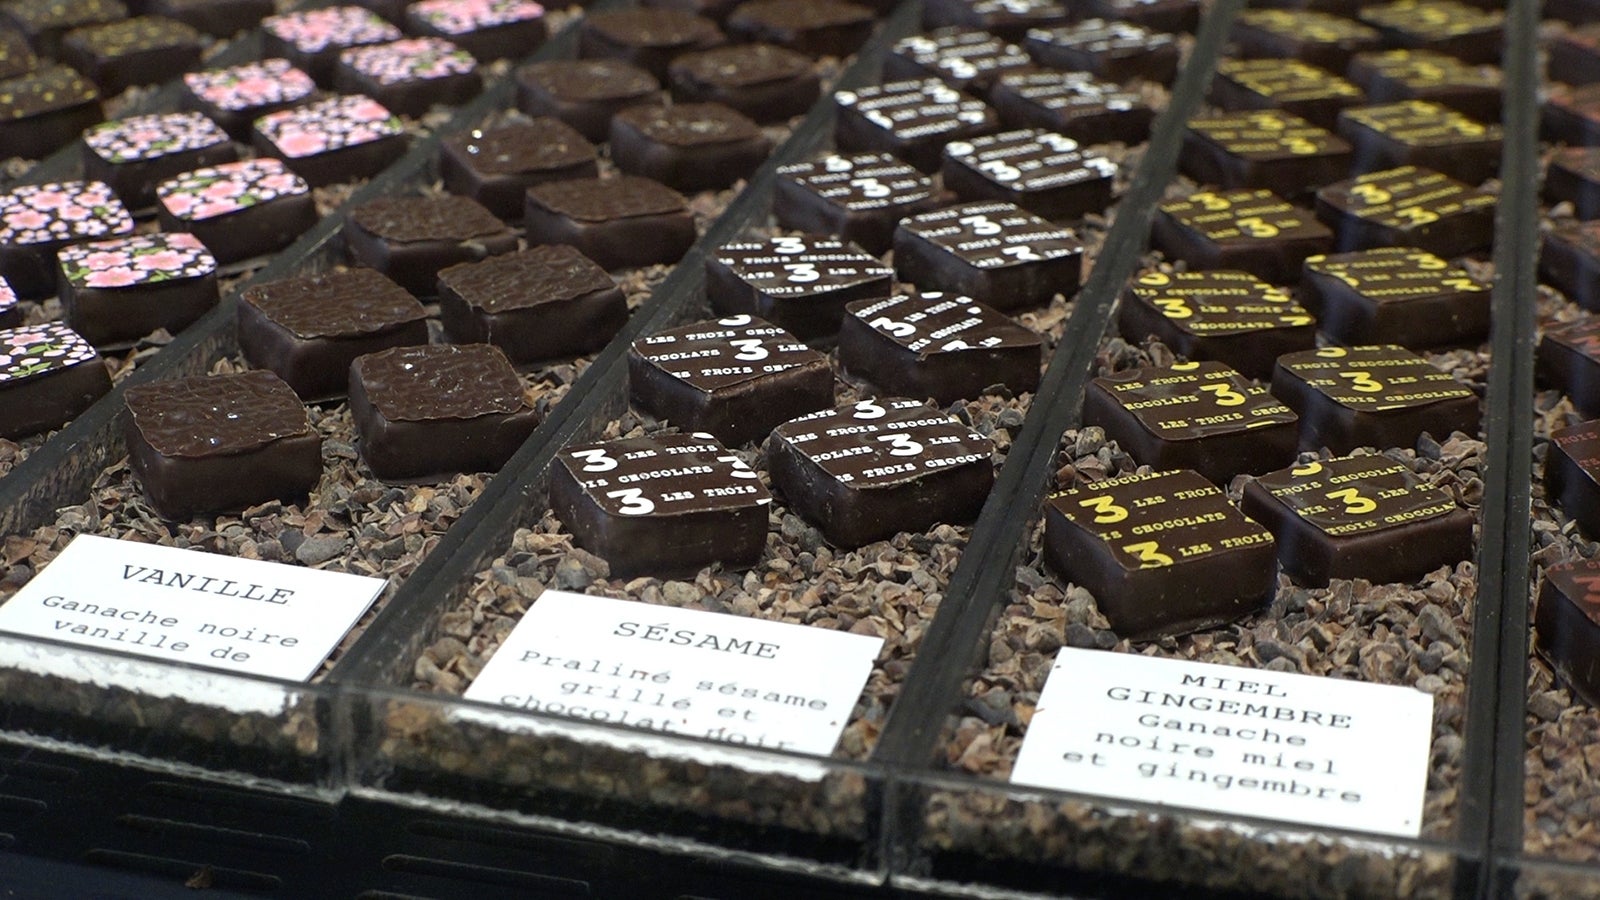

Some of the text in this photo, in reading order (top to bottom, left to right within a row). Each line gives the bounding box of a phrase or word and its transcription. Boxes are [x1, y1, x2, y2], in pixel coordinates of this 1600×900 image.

[978, 160, 1021, 181] 3
[850, 178, 891, 197] 3
[959, 215, 1001, 235] 3
[771, 238, 806, 254] 3
[1407, 253, 1447, 269] 3
[784, 264, 820, 282] 3
[1153, 299, 1192, 318] 3
[645, 335, 676, 344] LES
[686, 330, 736, 340] TROIS
[869, 316, 916, 336] 3
[645, 339, 808, 362] OCOLATS 3 LES
[701, 367, 752, 376] TROIS
[1292, 362, 1340, 370] TROIS
[1114, 382, 1144, 392] LES
[1150, 375, 1197, 386] TROIS
[1339, 372, 1383, 393] 3
[1387, 376, 1417, 385] LES
[892, 400, 922, 409] LES
[1199, 383, 1246, 406] 3
[1385, 389, 1473, 402] CHOCOLATS
[1158, 406, 1290, 429] LES TROIS CHOC
[786, 433, 818, 444] LES
[827, 425, 878, 437] TROIS
[571, 445, 718, 472] 3 LES TROIS
[810, 445, 873, 463] COLATS
[877, 433, 923, 456] 3
[929, 436, 960, 445] LES
[619, 465, 713, 484] CHOCOLATS
[863, 463, 916, 478] TROIS
[607, 485, 757, 515] 3 LES TROIS
[1272, 481, 1323, 498] TROIS
[1325, 488, 1377, 514] 3
[1378, 489, 1408, 499] LES
[1079, 496, 1128, 523] 3
[1133, 496, 1166, 508] LES
[1132, 512, 1226, 535] CHOCOLATS
[1326, 520, 1377, 535] TROIS
[1122, 531, 1274, 569] 3 LES TROIS
[122, 565, 295, 606] VANILLE
[42, 596, 298, 648] Ganache noire
[54, 620, 251, 662] vanille de
[614, 622, 781, 659] SÉSAME
[520, 650, 828, 711] Praliné sésame
[1181, 673, 1288, 698] MIEL
[560, 681, 758, 721] grillé et
[1107, 687, 1352, 729] GINGEMBRE
[501, 691, 686, 735] chocolat
[1138, 713, 1307, 746] Ganache
[1096, 731, 1338, 775] noire miel
[1063, 750, 1361, 804] et gingembre
